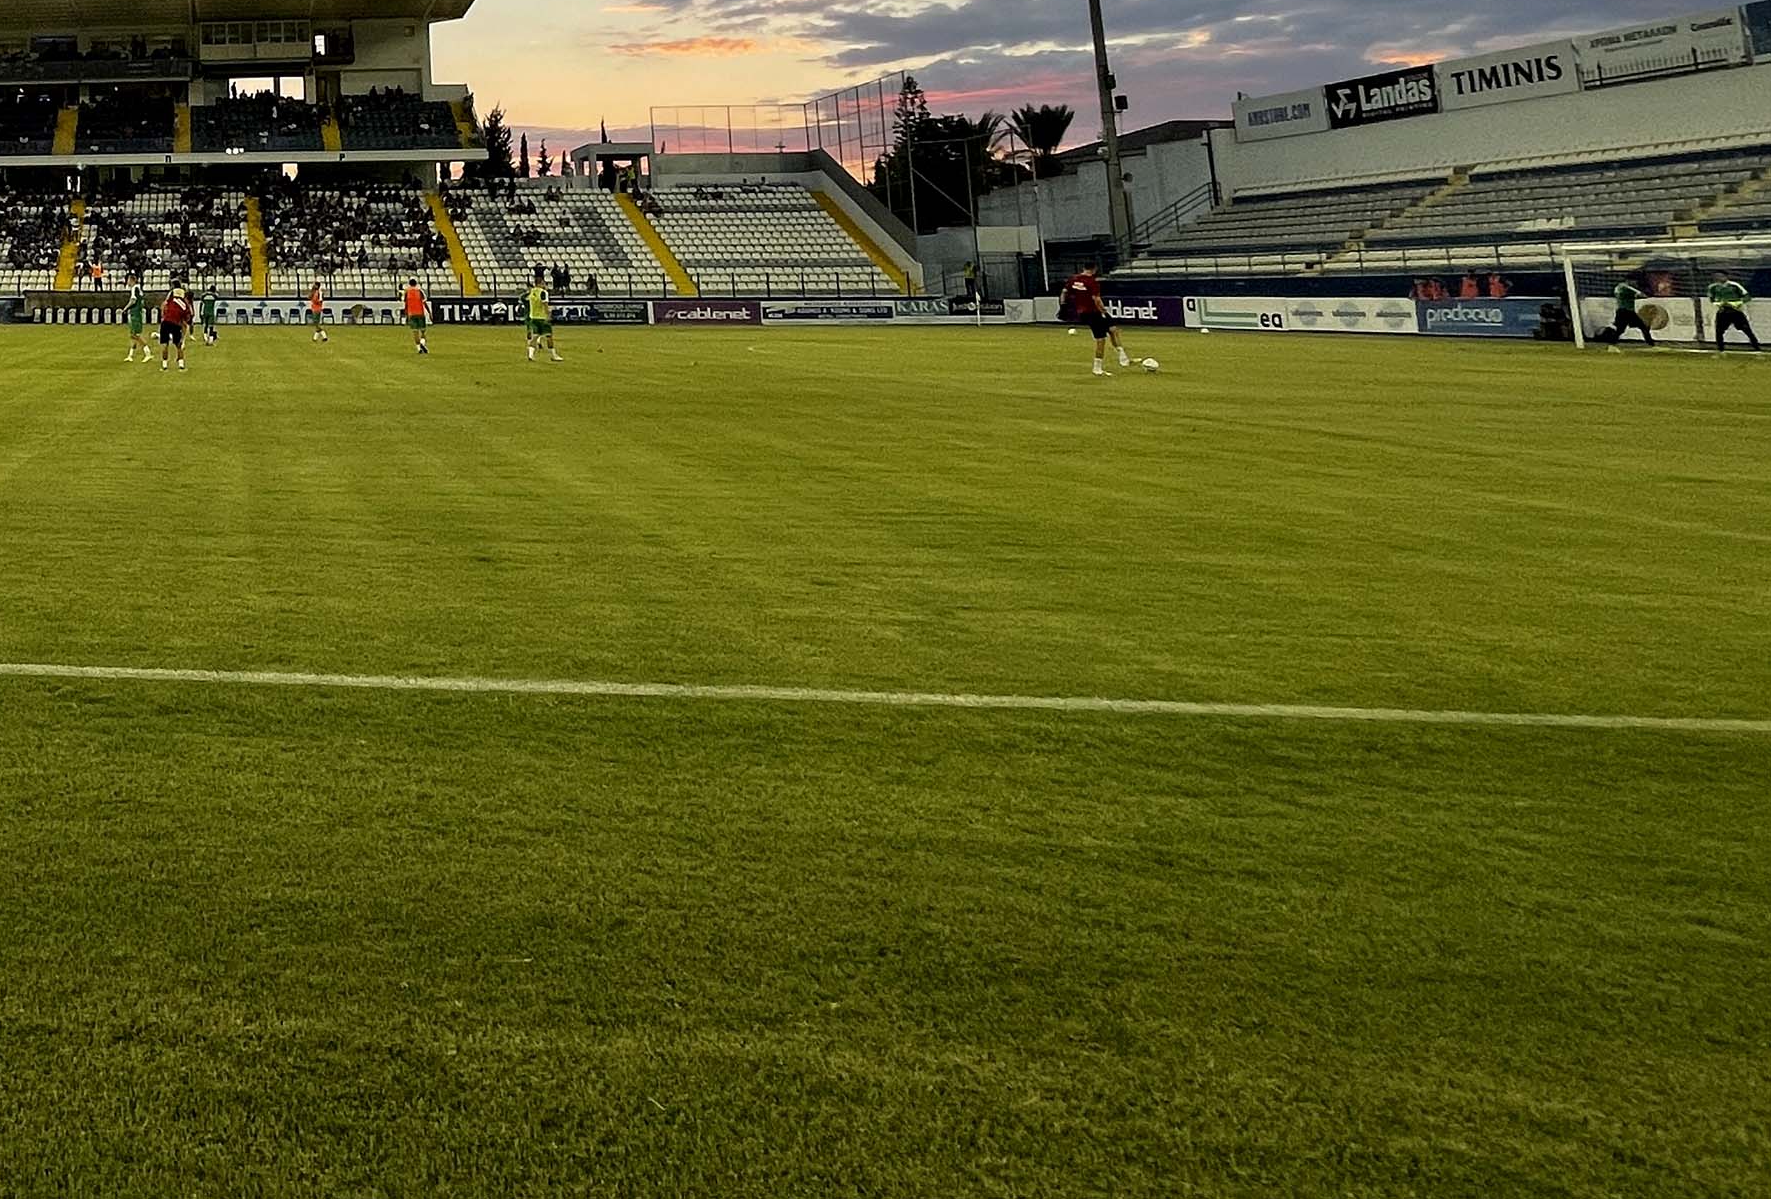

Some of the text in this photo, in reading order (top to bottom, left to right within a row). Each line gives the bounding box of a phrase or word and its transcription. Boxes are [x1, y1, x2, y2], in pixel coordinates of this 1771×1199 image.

[1450, 55, 1562, 95] TIMINIS
[1358, 77, 1432, 111] Landas
[677, 307, 751, 320] cablenet
[897, 300, 949, 312] KARAS
